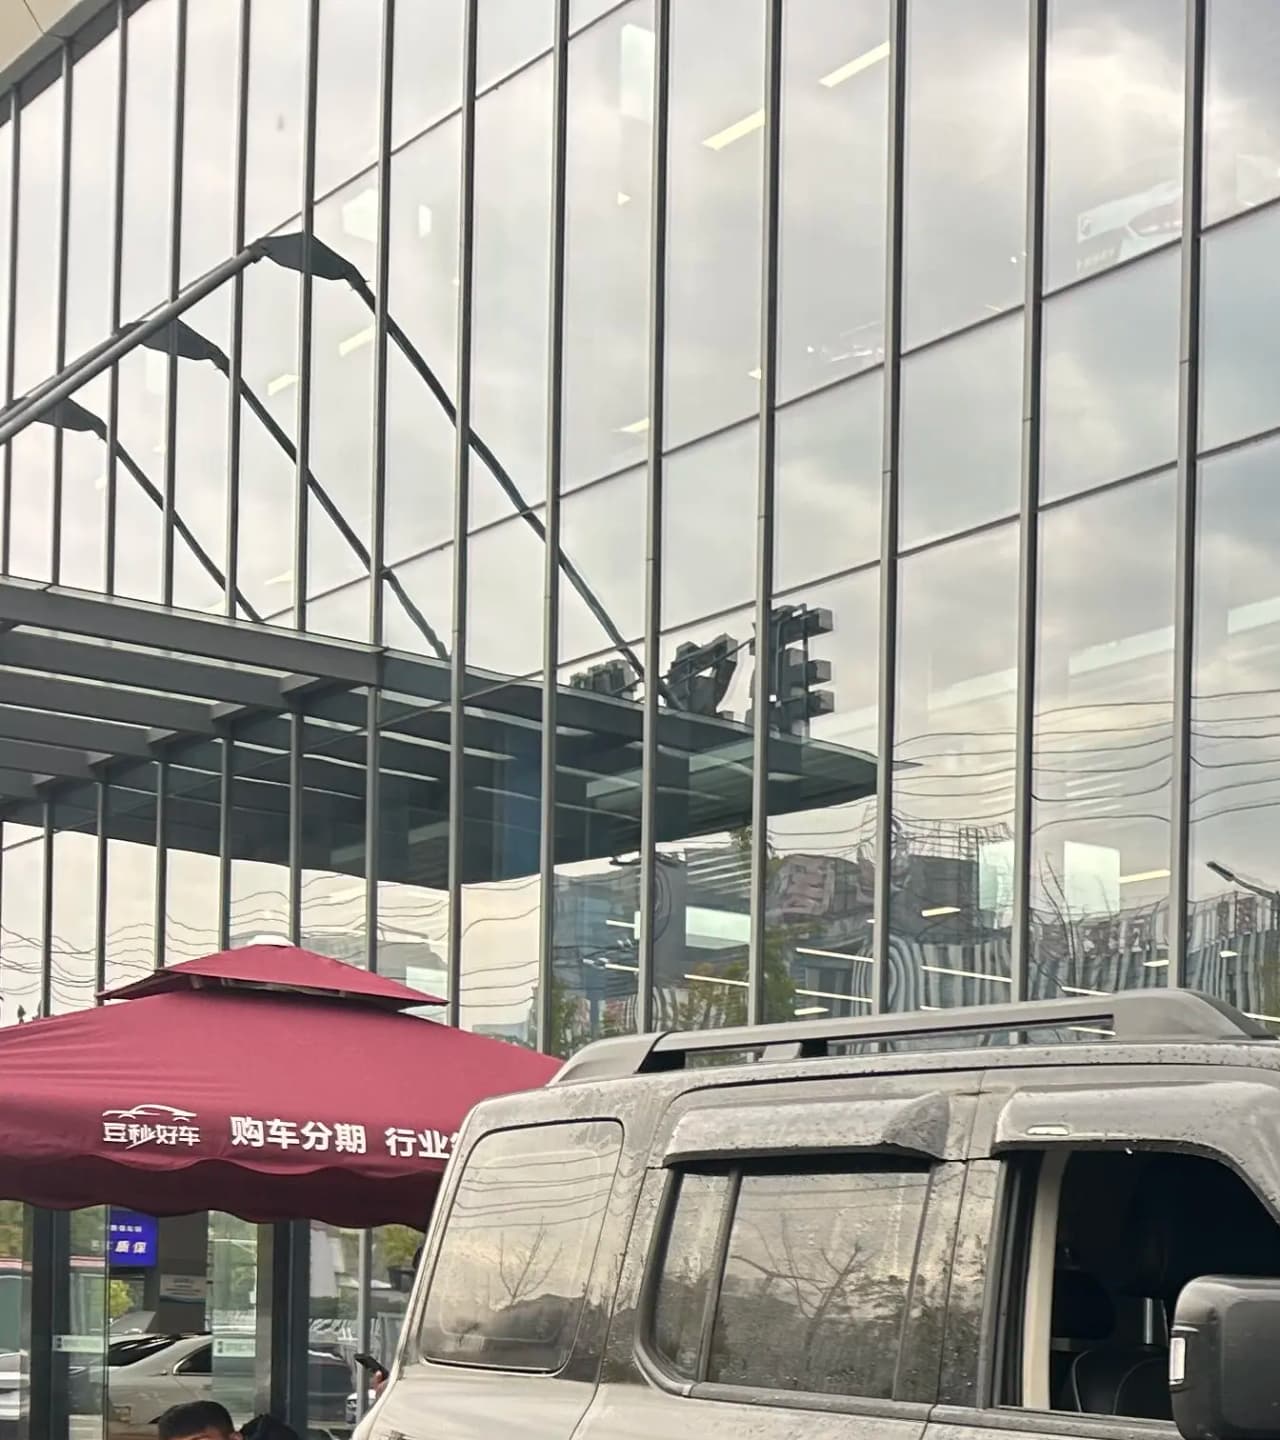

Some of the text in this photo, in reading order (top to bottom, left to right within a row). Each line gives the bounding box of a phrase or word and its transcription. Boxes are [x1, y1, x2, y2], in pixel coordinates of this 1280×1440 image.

[102, 1121, 201, 1150] 豆秒好车
[229, 1116, 462, 1160] 购车分期 行业
